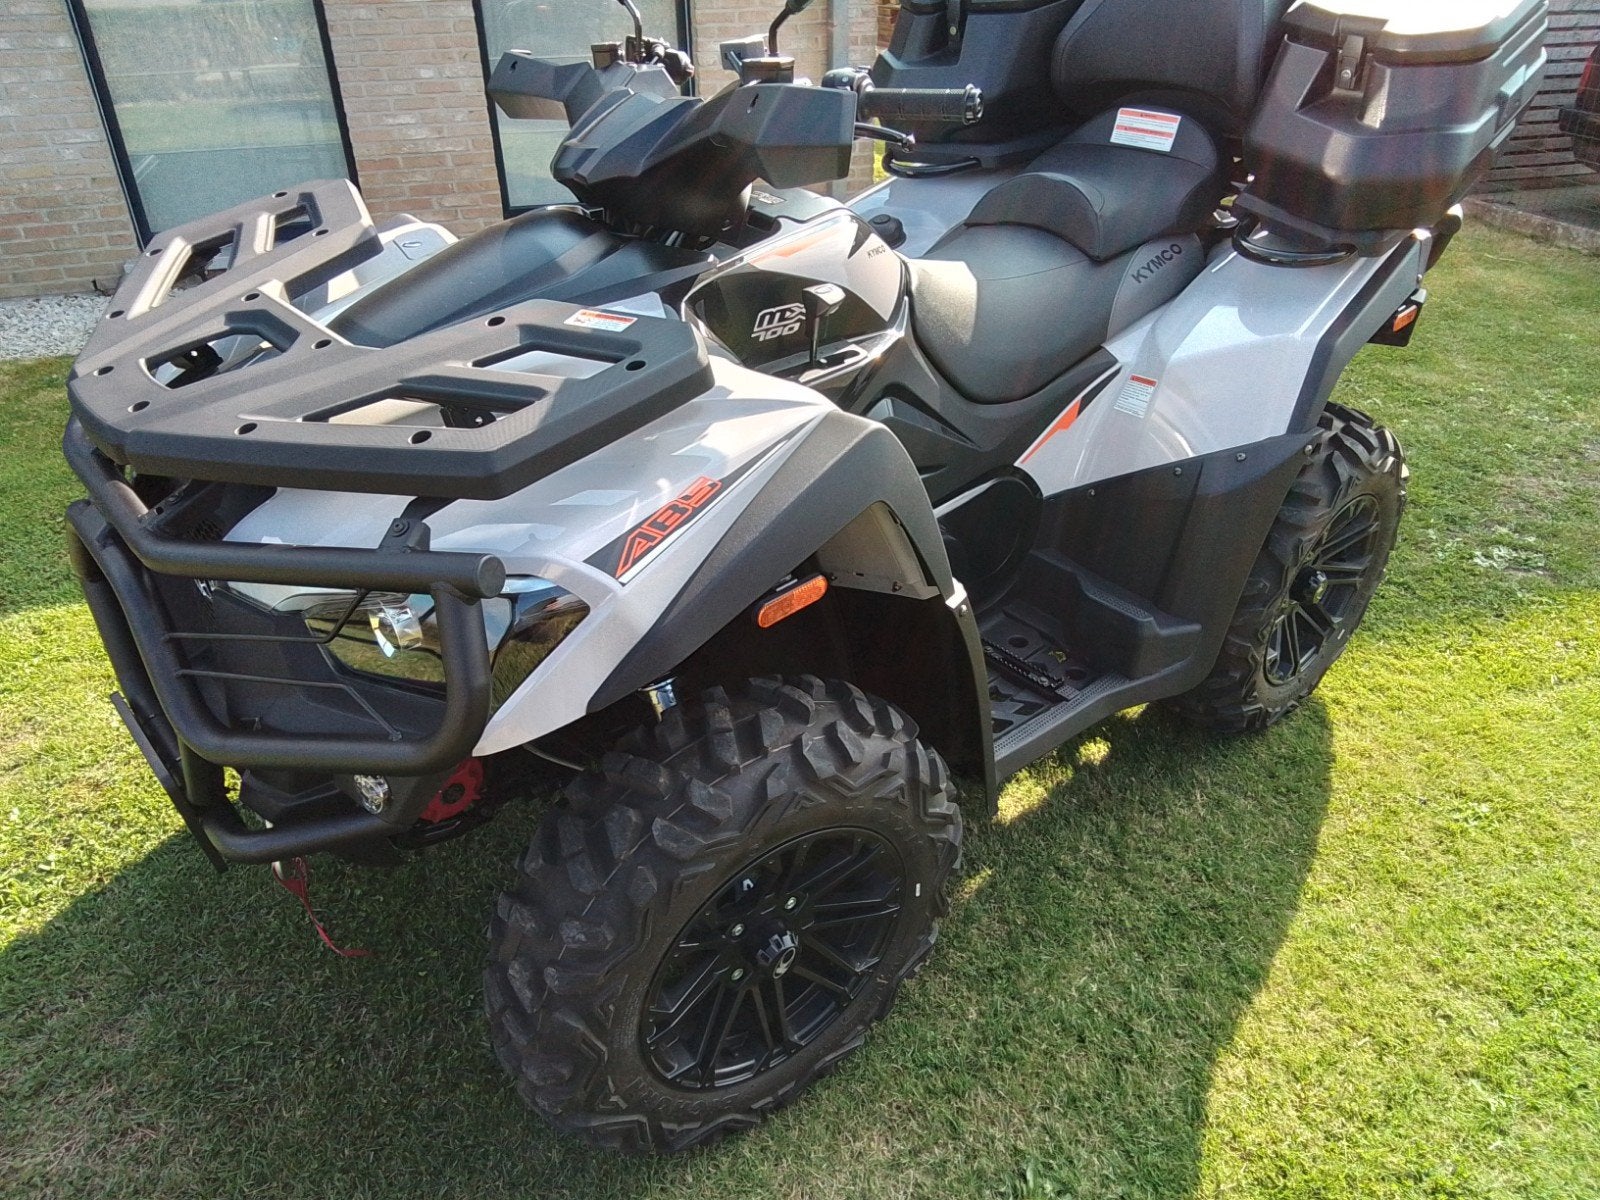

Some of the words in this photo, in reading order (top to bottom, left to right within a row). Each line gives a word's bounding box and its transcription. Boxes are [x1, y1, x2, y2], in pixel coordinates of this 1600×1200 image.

[1131, 243, 1183, 284] KYMCO
[750, 322, 801, 342] 700
[615, 474, 722, 579] ABS
